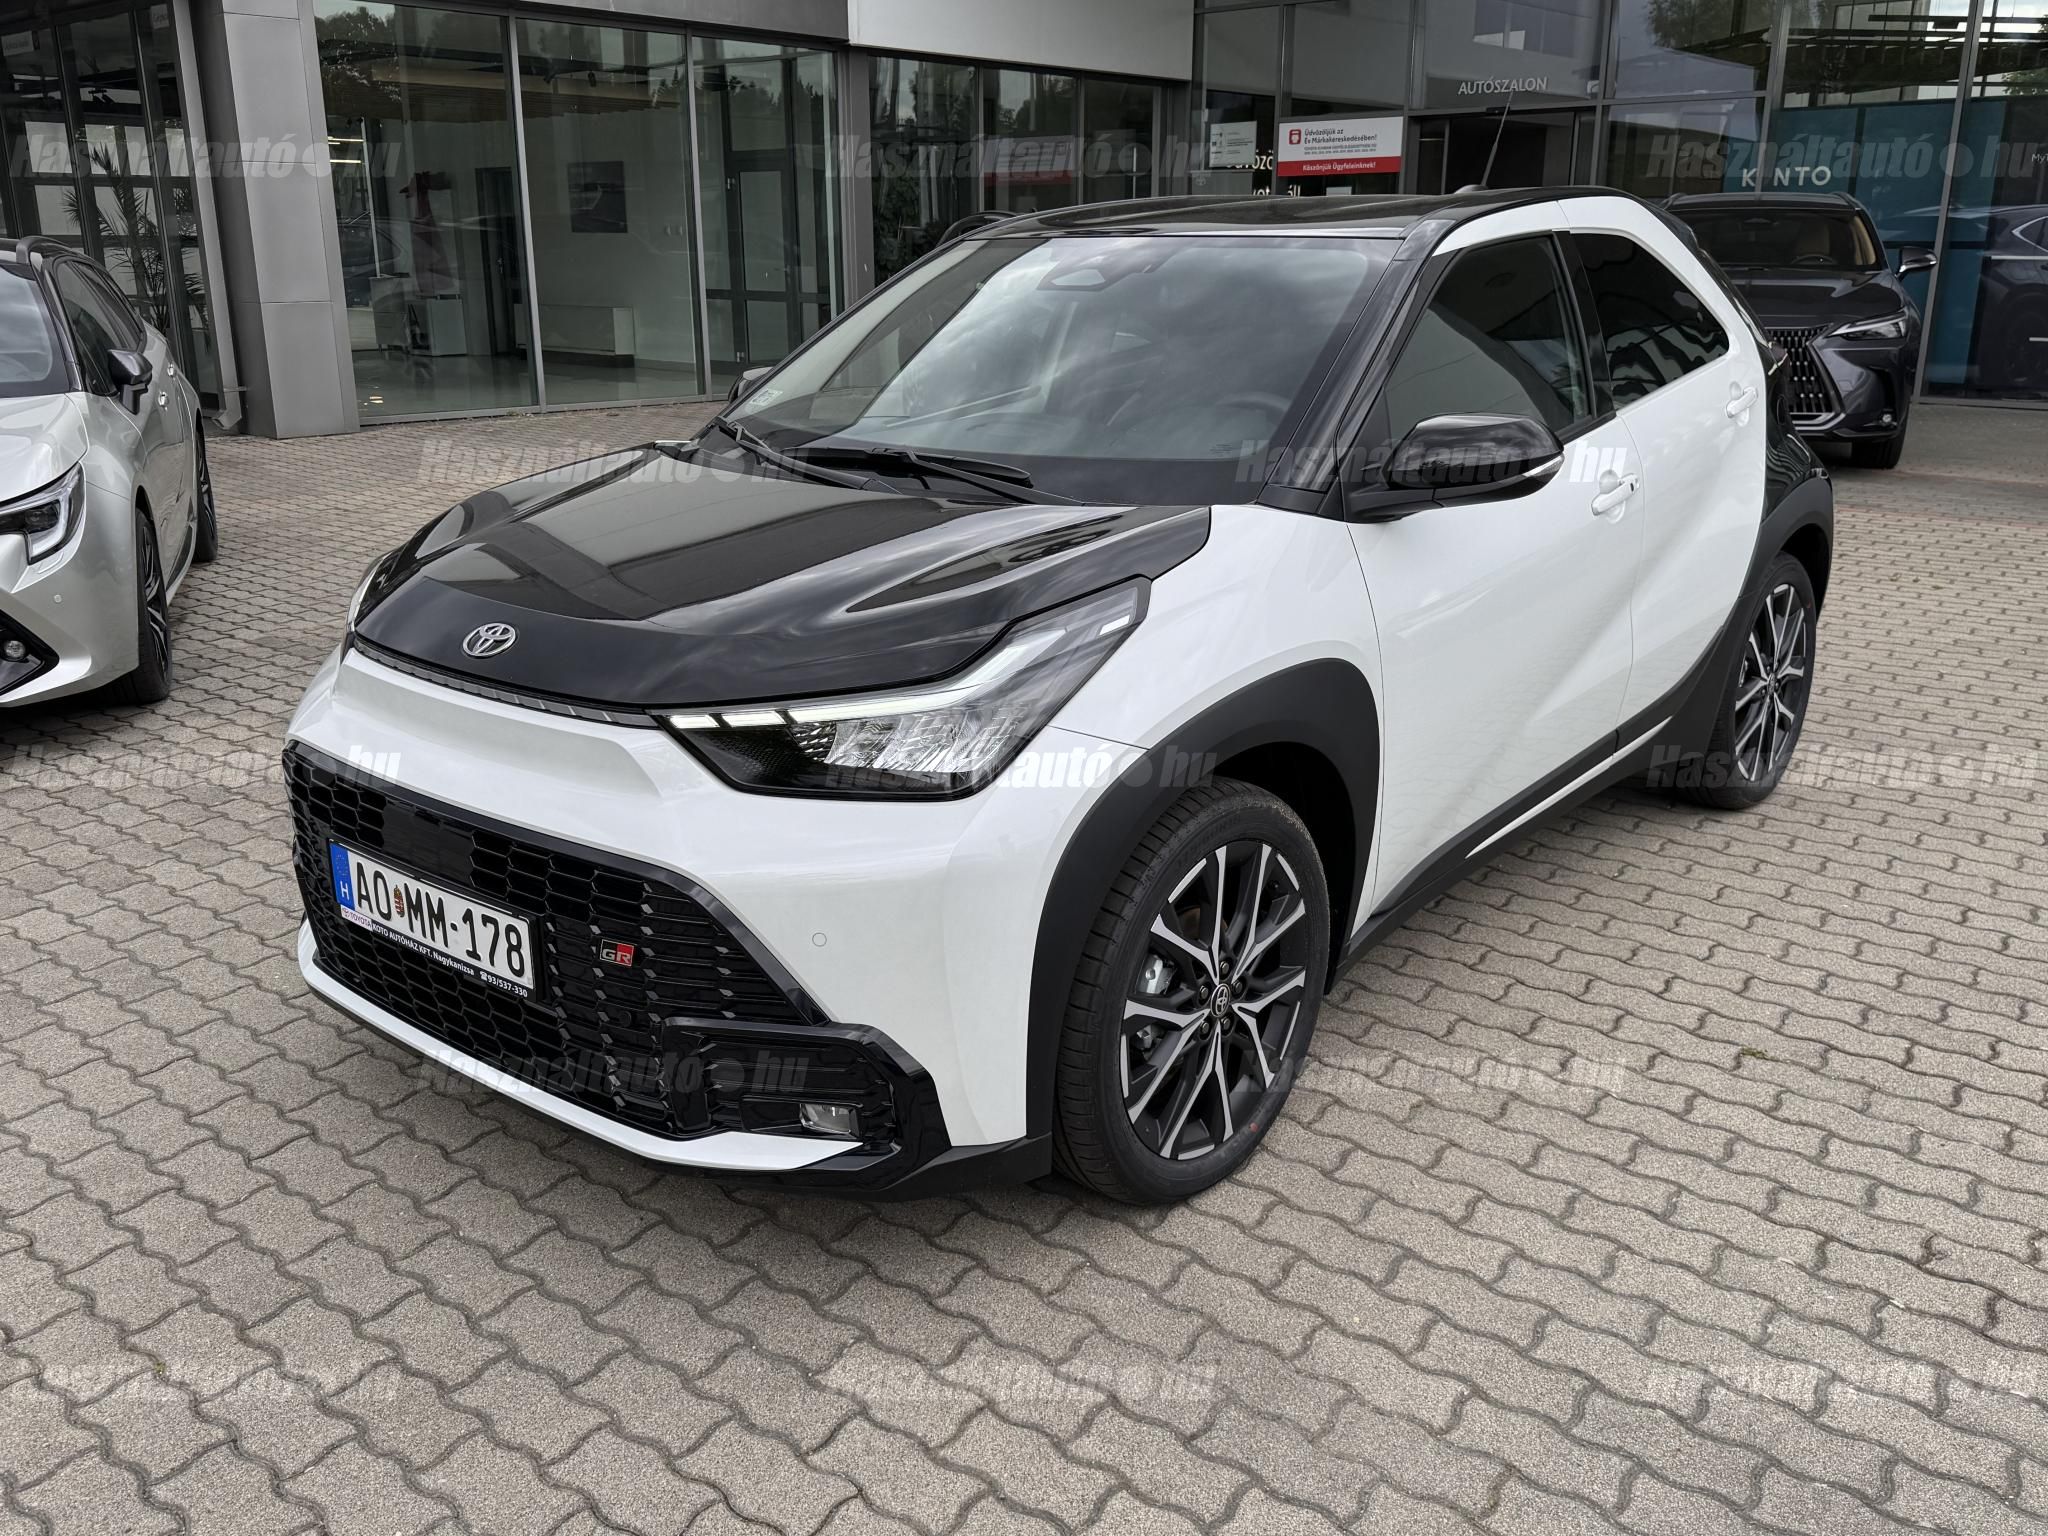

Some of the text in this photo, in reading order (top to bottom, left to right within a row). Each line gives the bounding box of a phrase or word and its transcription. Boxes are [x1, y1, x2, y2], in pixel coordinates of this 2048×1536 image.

[1457, 75, 1548, 95] AUTÓSZALON
[1741, 165, 1832, 187] KNTO
[340, 880, 350, 900] H
[350, 911, 373, 928] TOYOTA
[356, 862, 525, 978] AO MM-178
[433, 952, 475, 976] Nagykanizsa
[602, 948, 631, 965] GR
